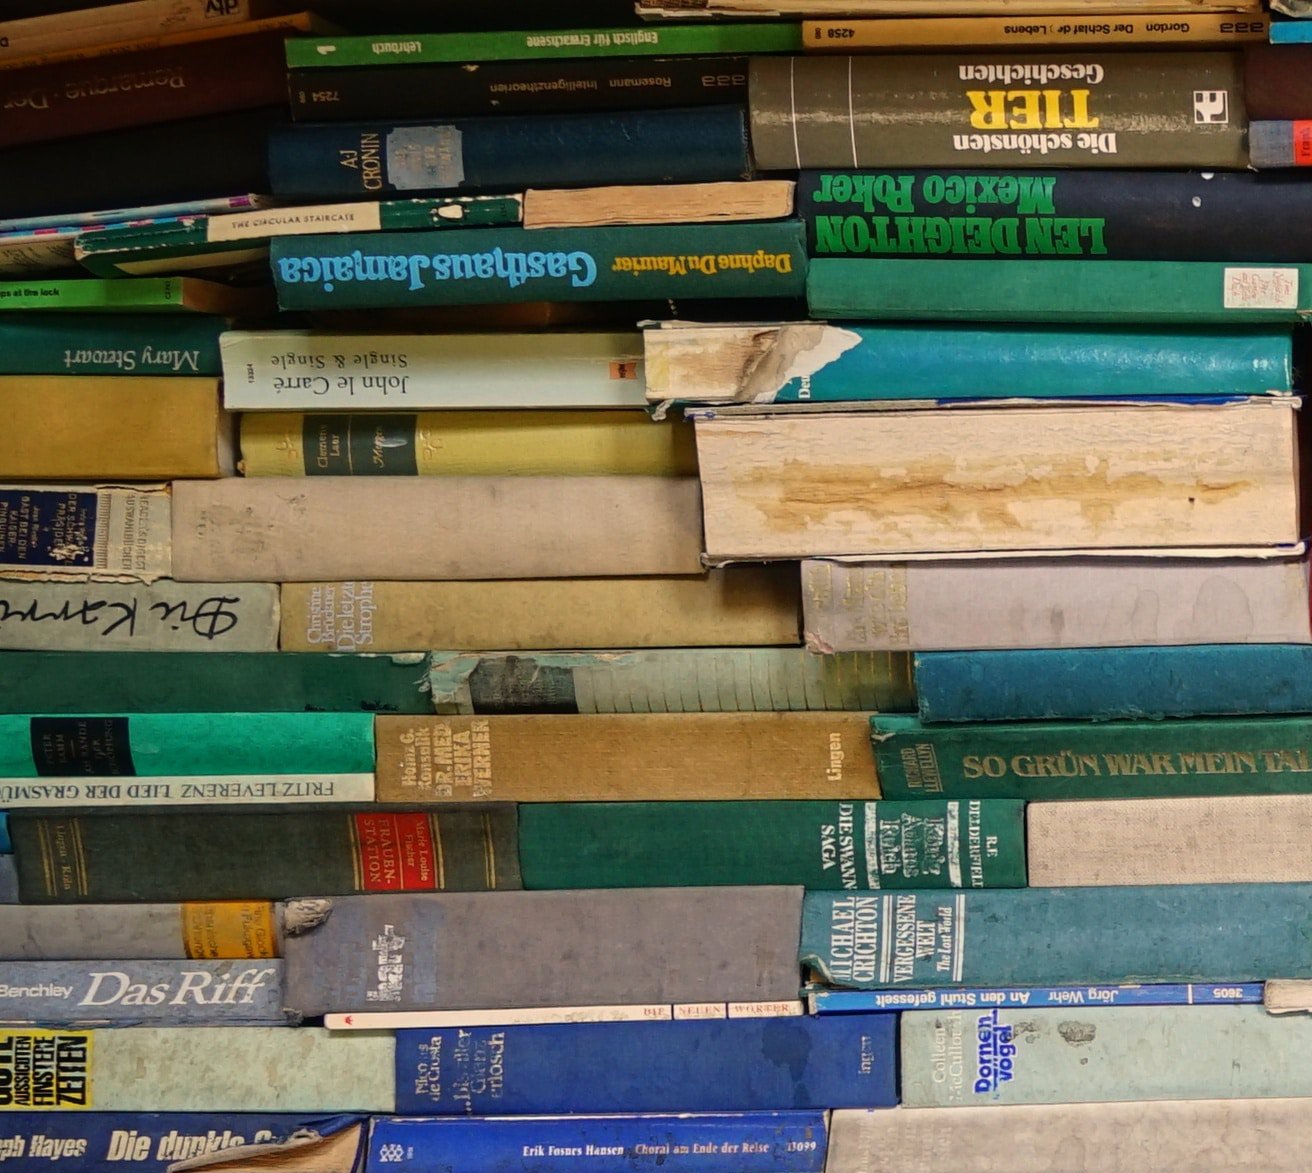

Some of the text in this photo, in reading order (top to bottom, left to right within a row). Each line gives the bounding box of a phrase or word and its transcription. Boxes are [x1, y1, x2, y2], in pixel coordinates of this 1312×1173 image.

[959, 62, 1104, 85] Geschichten
[967, 89, 1099, 130] TIER
[954, 133, 1118, 154] Die schönsten
[813, 174, 1056, 214] Mexico Poker
[816, 216, 1107, 255] LEN DEIGHTON
[278, 256, 428, 291] Jamaica
[432, 249, 598, 288] Gasthaus
[612, 250, 792, 275] Daphne Du Maurier
[273, 374, 408, 396] John le Carré
[828, 732, 845, 781] Lingen
[963, 756, 1005, 776] SO
[1012, 750, 1100, 778] GRÜN
[1104, 754, 1178, 775] WAR
[1179, 753, 1257, 773] MEIN
[79, 968, 276, 1006] Das Riff
[975, 1014, 992, 1093] Dornen
[998, 1025, 1014, 1083] vogel
